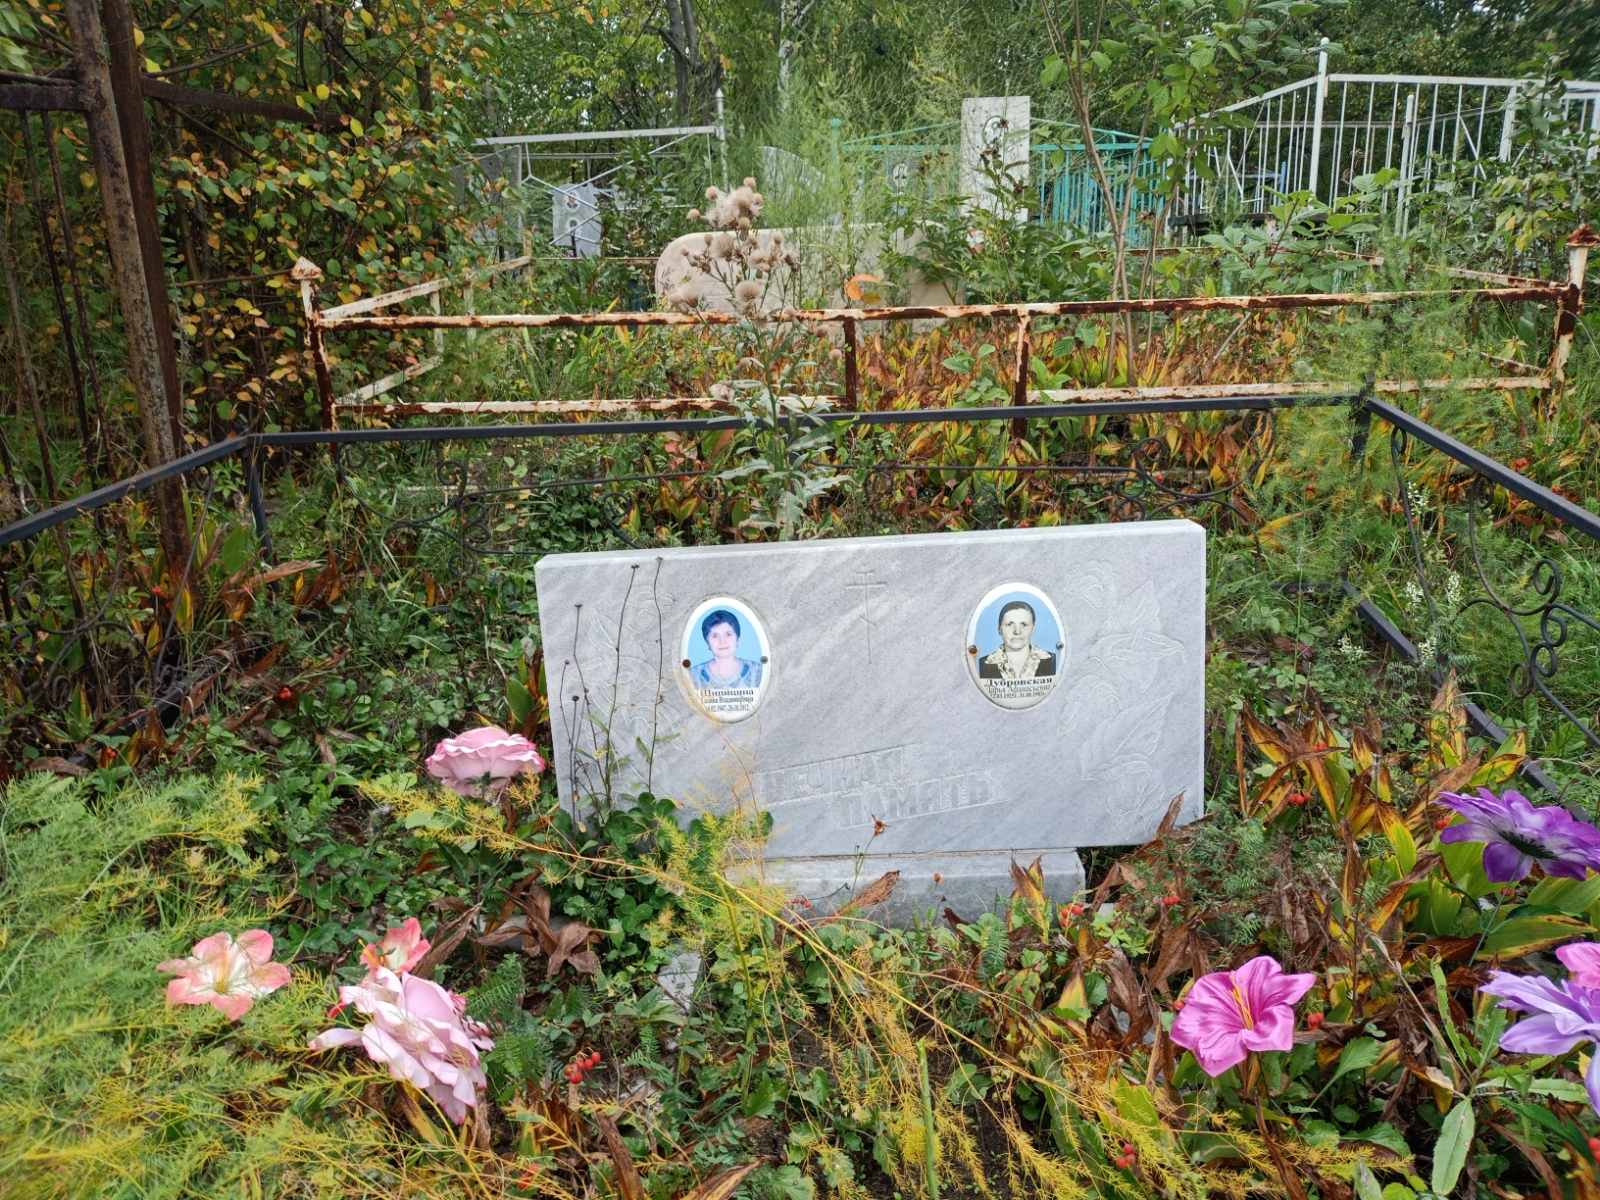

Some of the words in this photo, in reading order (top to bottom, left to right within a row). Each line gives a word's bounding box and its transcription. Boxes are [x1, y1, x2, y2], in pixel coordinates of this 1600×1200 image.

[984, 678, 1052, 687] Дубровская
[763, 747, 906, 804] ВЕЧНАЯ
[840, 774, 992, 828] ПАМЯТЬ
